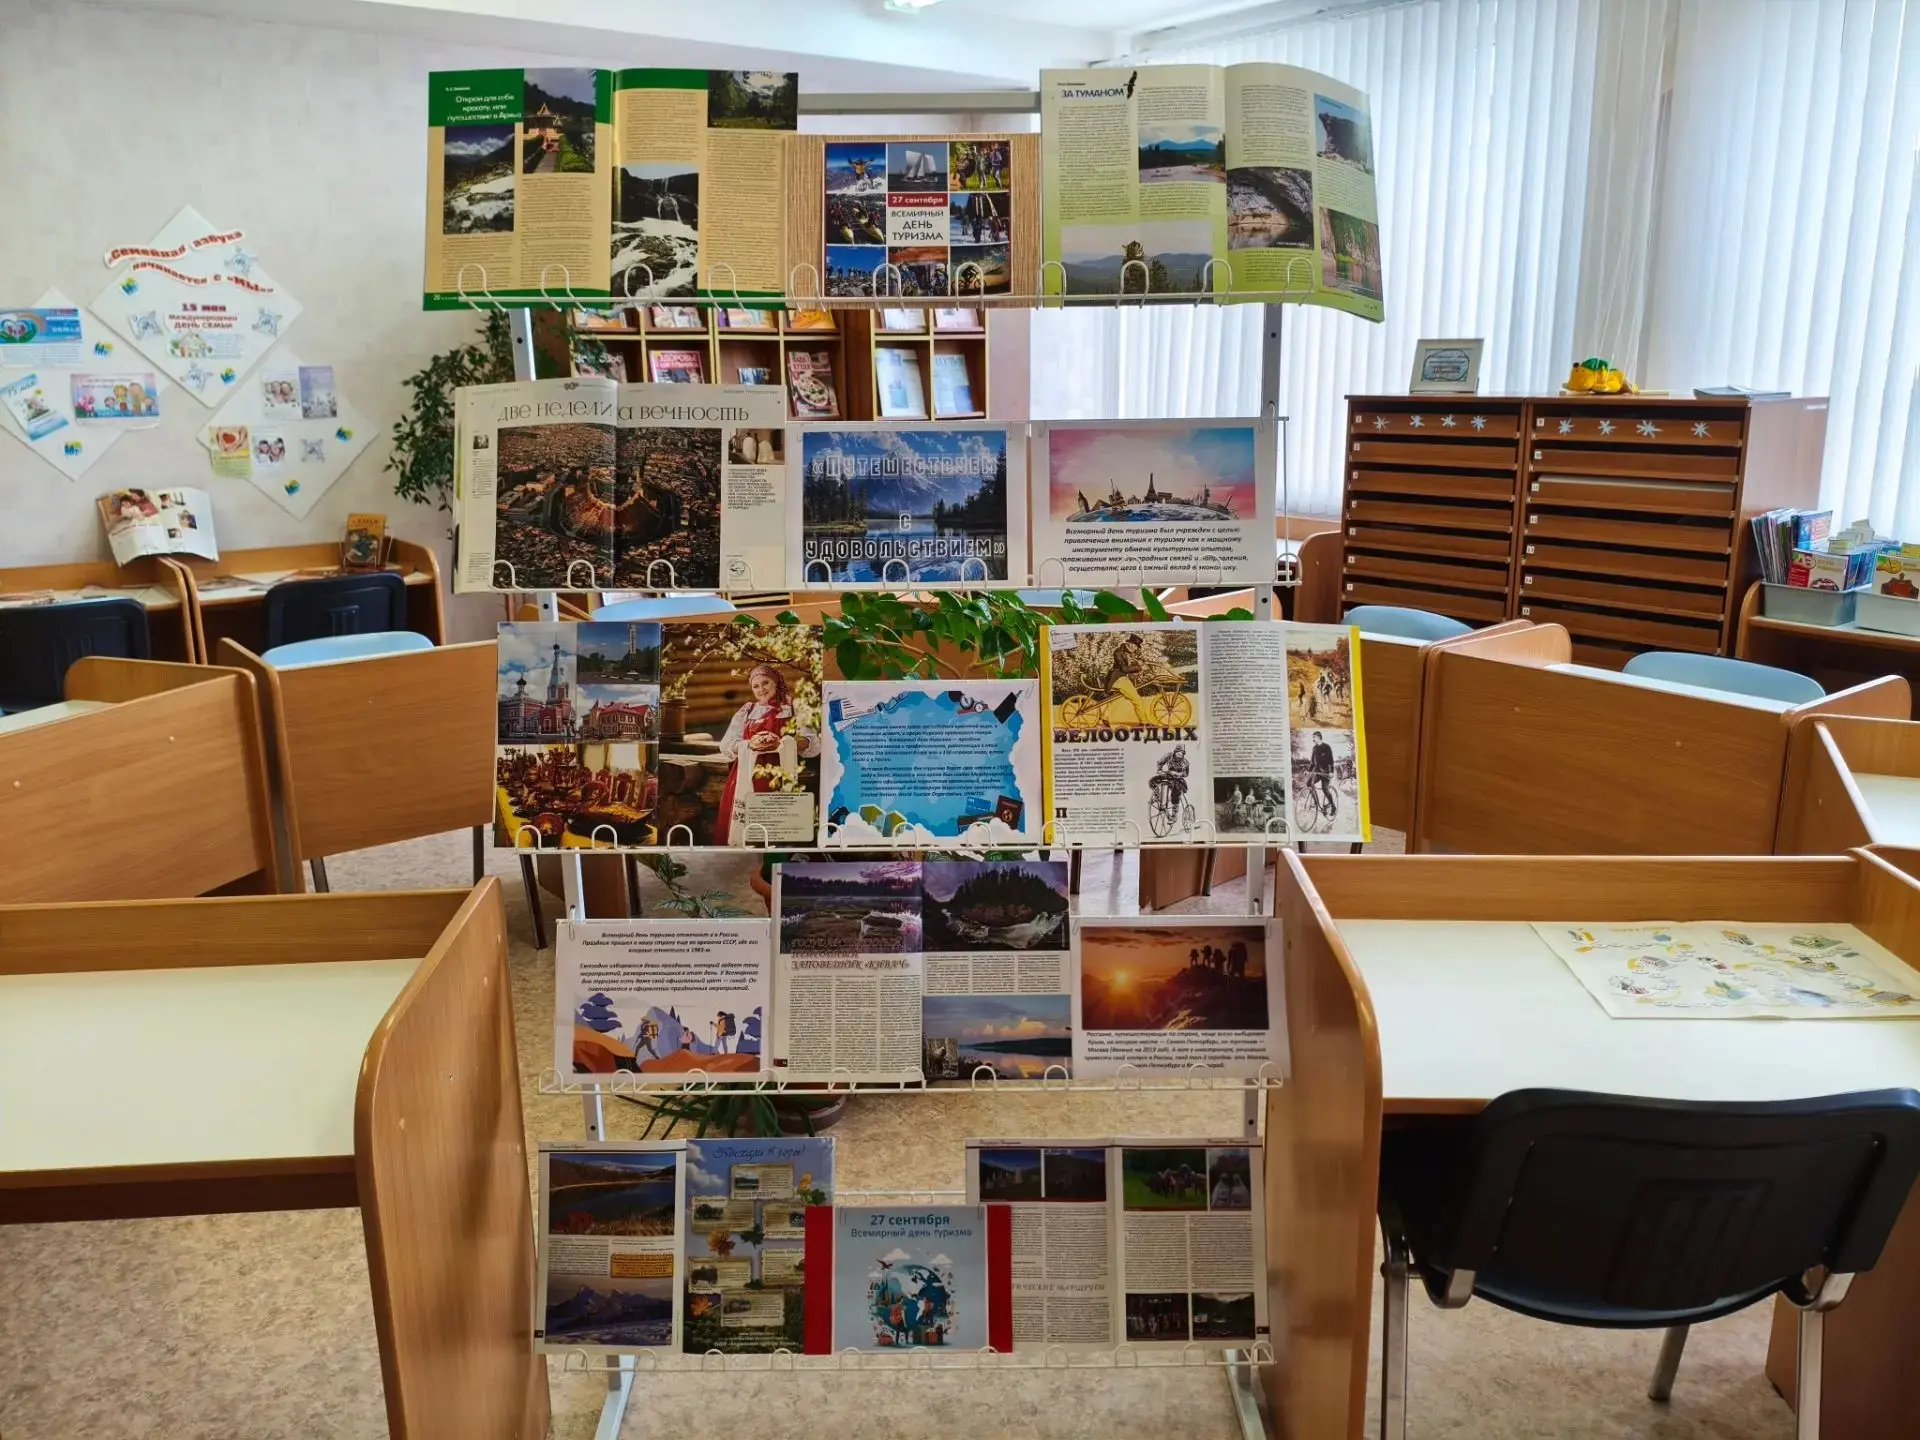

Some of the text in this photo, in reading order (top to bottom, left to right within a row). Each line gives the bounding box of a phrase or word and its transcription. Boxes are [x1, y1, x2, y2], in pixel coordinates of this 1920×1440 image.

[1061, 88, 1124, 98] ЗА ТУМАНОМ
[892, 196, 944, 205] 27 сентября
[891, 209, 944, 218] ВСЕМИРНЫЙ
[902, 220, 933, 230] ДЕНЬ
[193, 231, 242, 247] азбука
[892, 231, 944, 241] ТУРИЗМА
[182, 303, 198, 312] 15
[899, 512, 912, 530] С
[1053, 726, 1198, 744] ВЕЛООТДЫХ
[870, 1214, 950, 1228] 27 сентября
[850, 1228, 972, 1238] Всемирный день туризма
